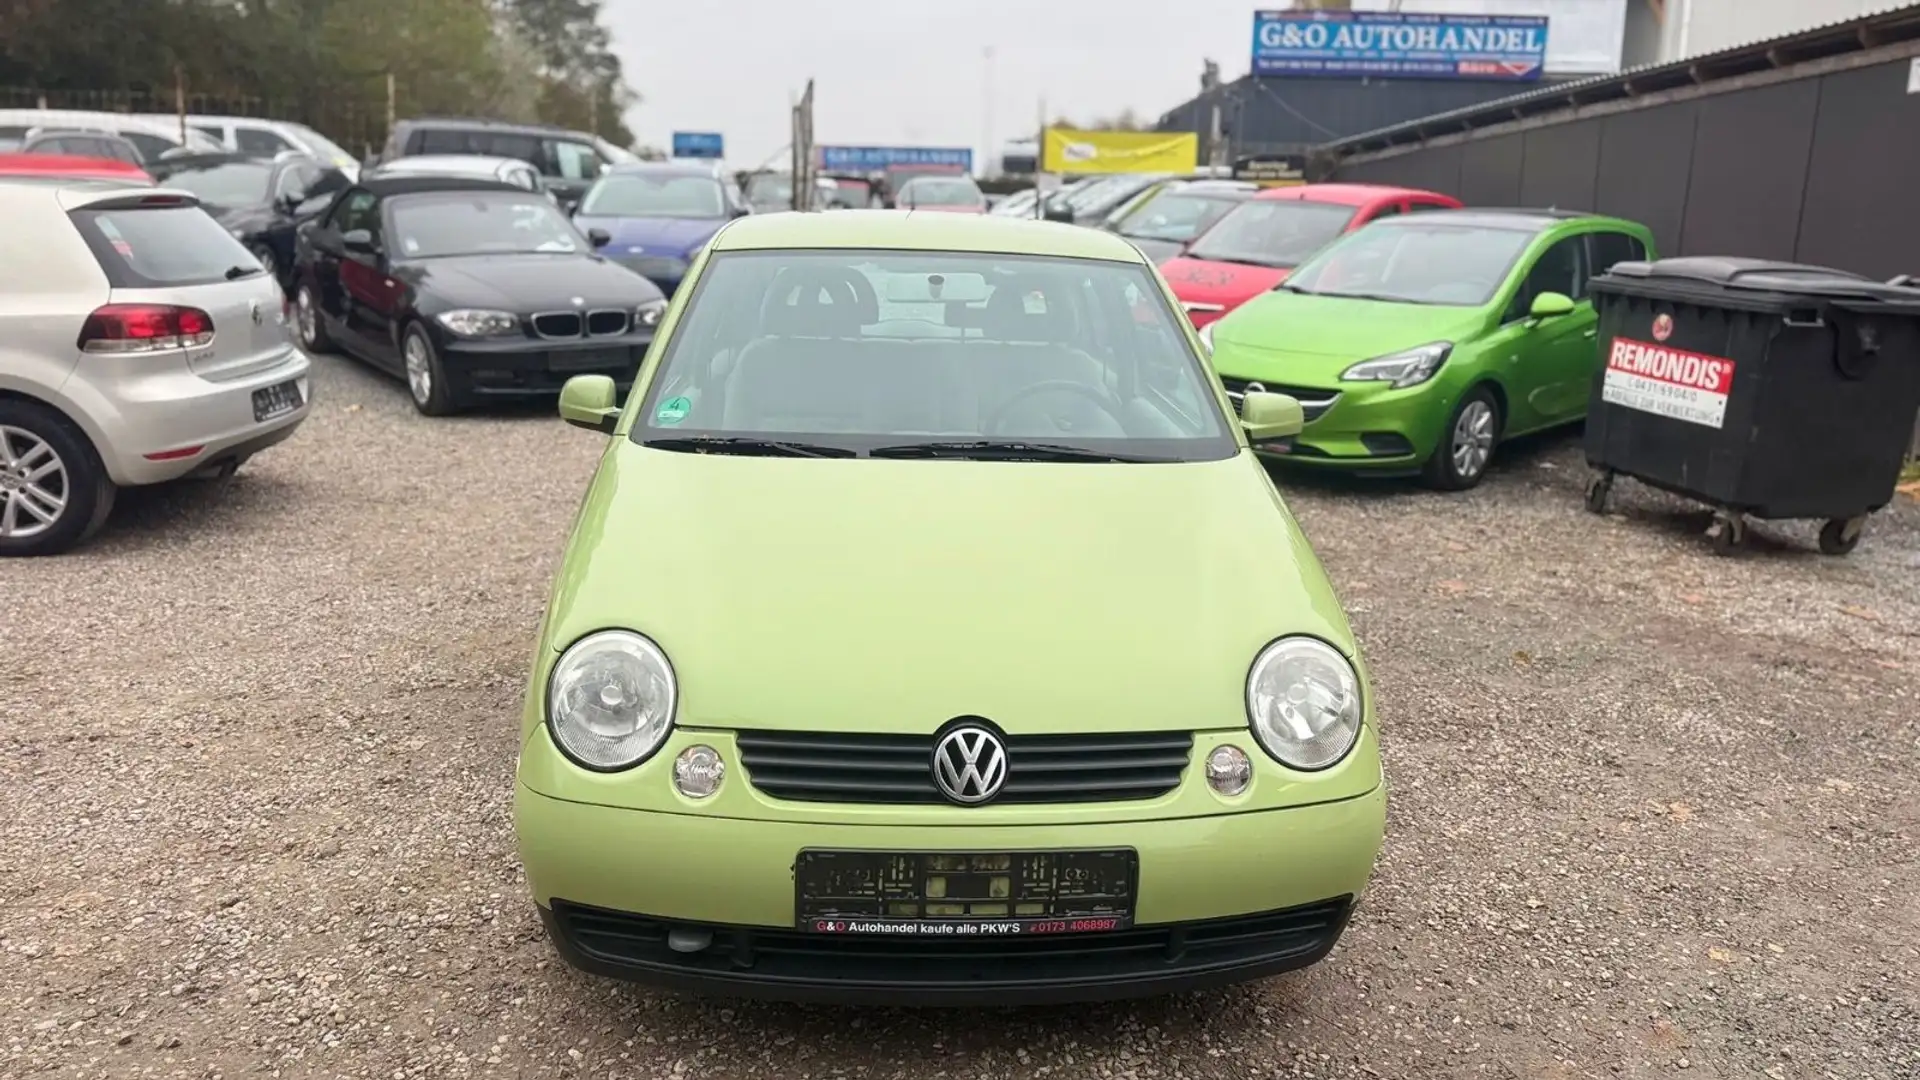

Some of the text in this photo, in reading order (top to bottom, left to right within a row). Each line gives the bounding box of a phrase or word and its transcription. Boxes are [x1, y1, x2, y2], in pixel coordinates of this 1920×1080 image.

[1259, 22, 1542, 52] G&O AUTOHANDEL
[1610, 340, 1722, 390] REMONDIS
[668, 396, 681, 411] 4
[816, 919, 1117, 934] G&O Autohandel kaufe alle PKW'S 0173 4068987
